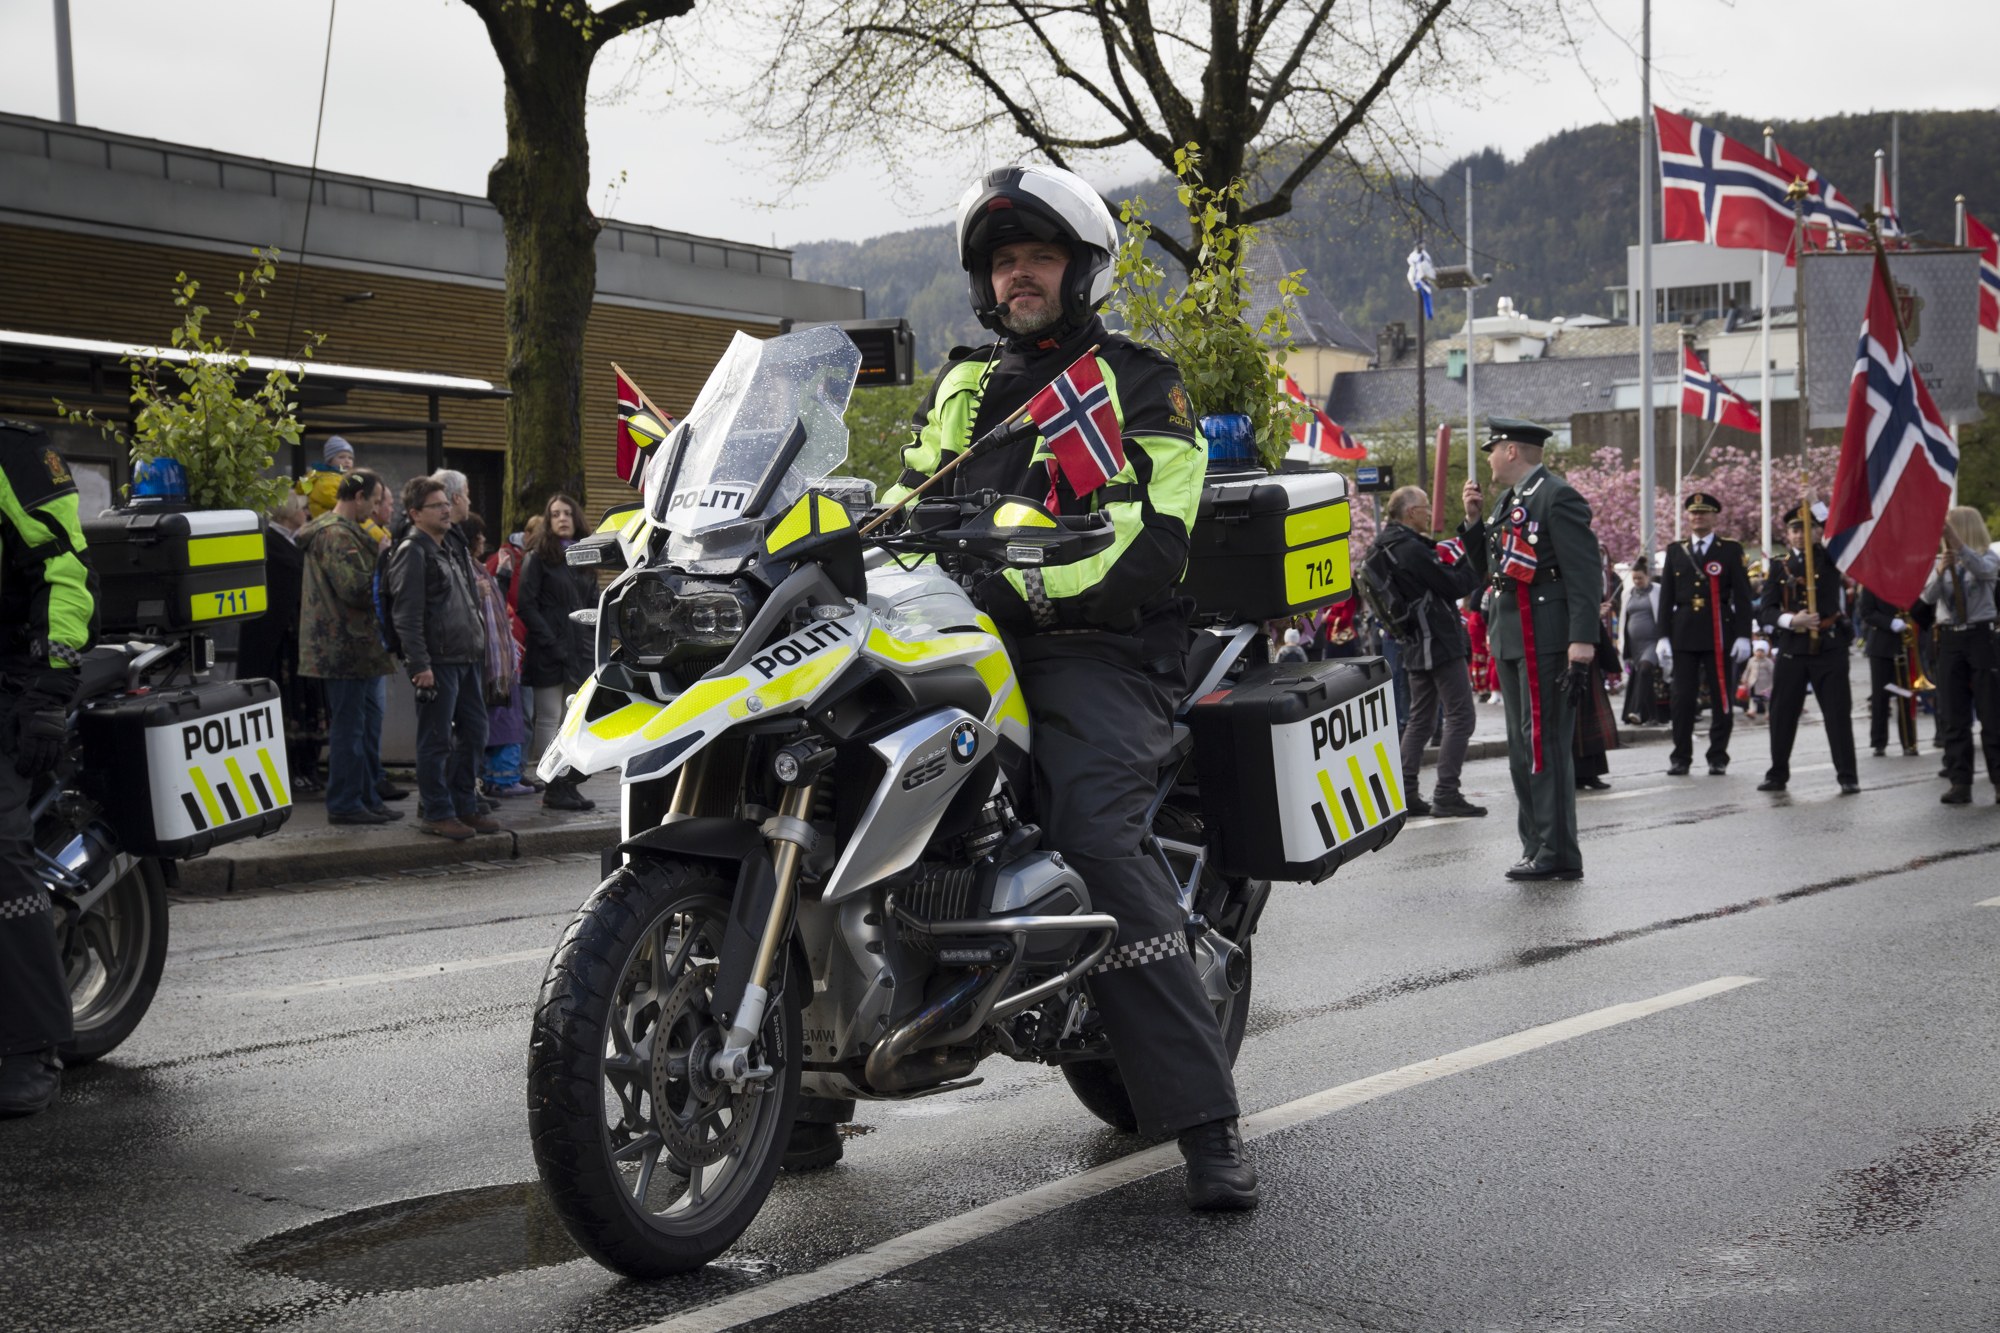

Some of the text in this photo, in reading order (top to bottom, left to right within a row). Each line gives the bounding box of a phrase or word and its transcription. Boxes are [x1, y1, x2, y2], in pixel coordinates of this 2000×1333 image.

[669, 489, 745, 512] POLITI
[1306, 558, 1334, 590] 712
[214, 590, 247, 615] 711
[750, 620, 852, 680] POLITI
[182, 706, 274, 761] POLITI
[1310, 687, 1389, 761] POLITI
[902, 754, 946, 791] GS
[773, 1014, 783, 1058] brembo
[802, 1029, 836, 1042] BMW
